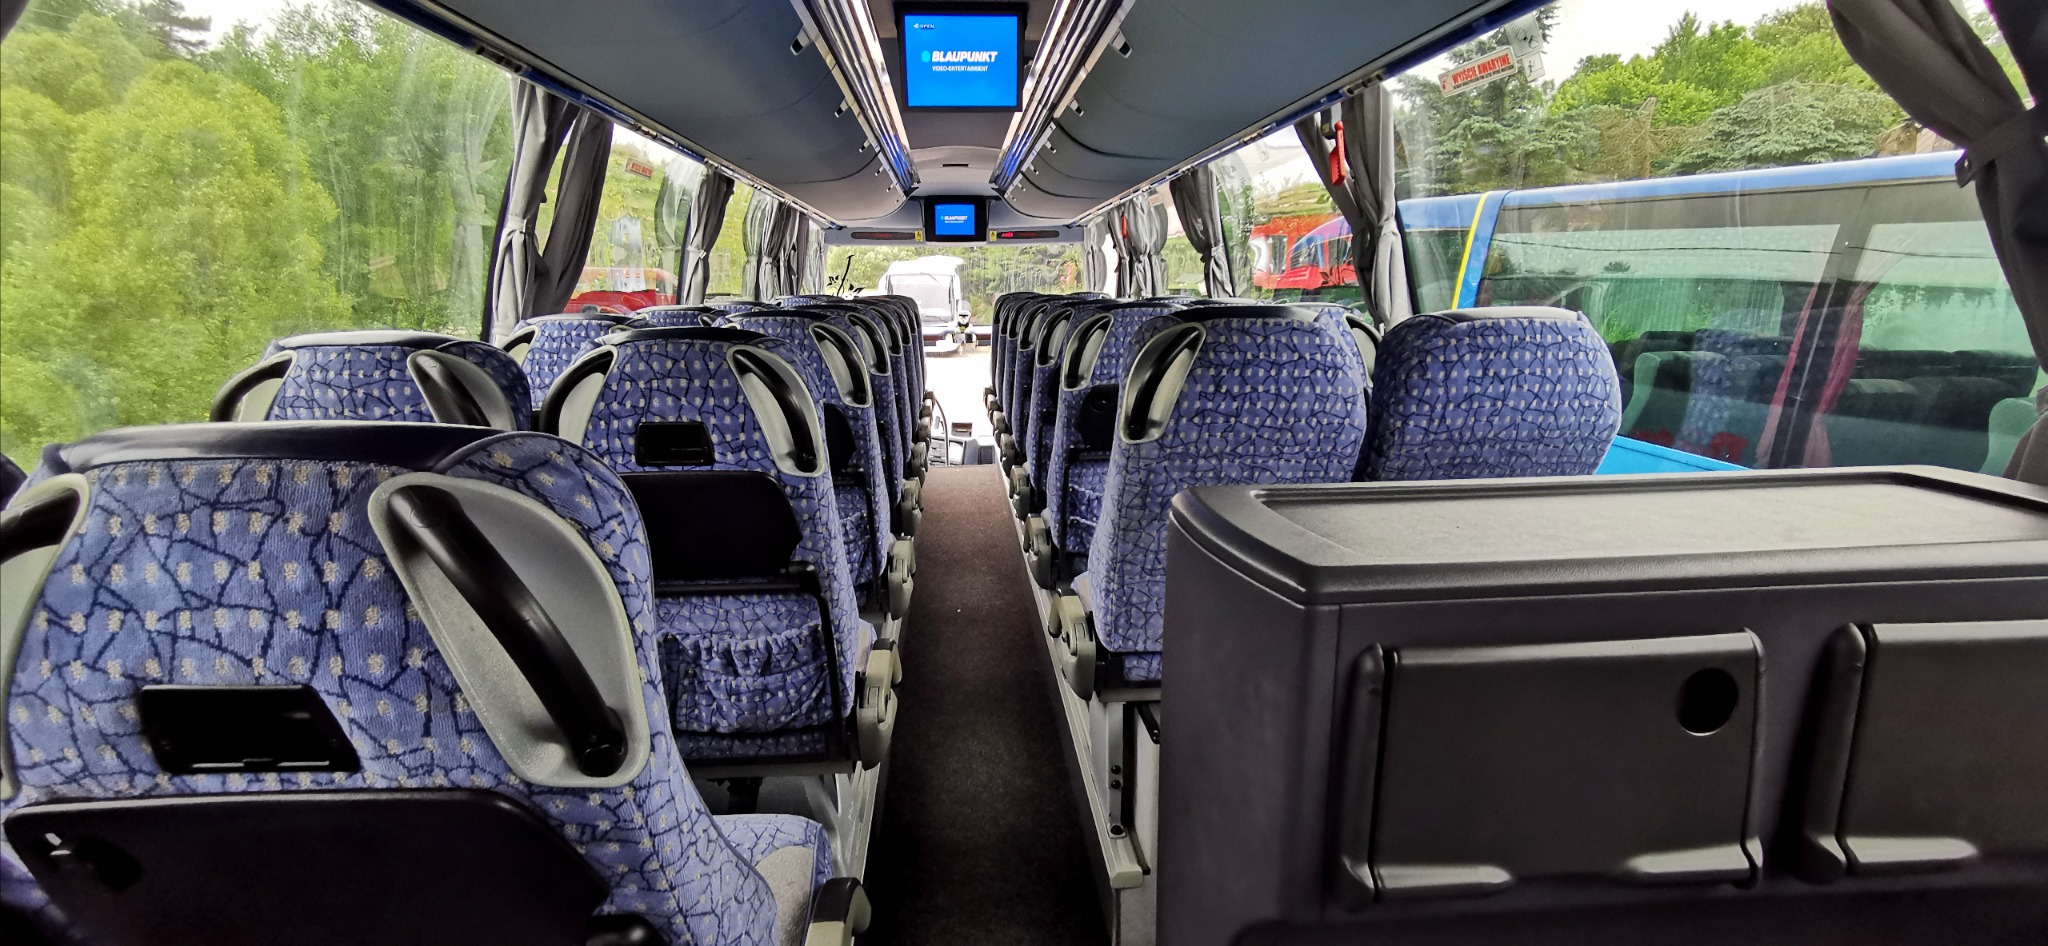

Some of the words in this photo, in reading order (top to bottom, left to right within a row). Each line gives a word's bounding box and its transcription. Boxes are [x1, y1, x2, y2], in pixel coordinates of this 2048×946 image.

[932, 50, 998, 62] BLAUPUNKT
[1451, 64, 1478, 85] WYJŚCIE
[1477, 53, 1511, 75] AWARYJNE
